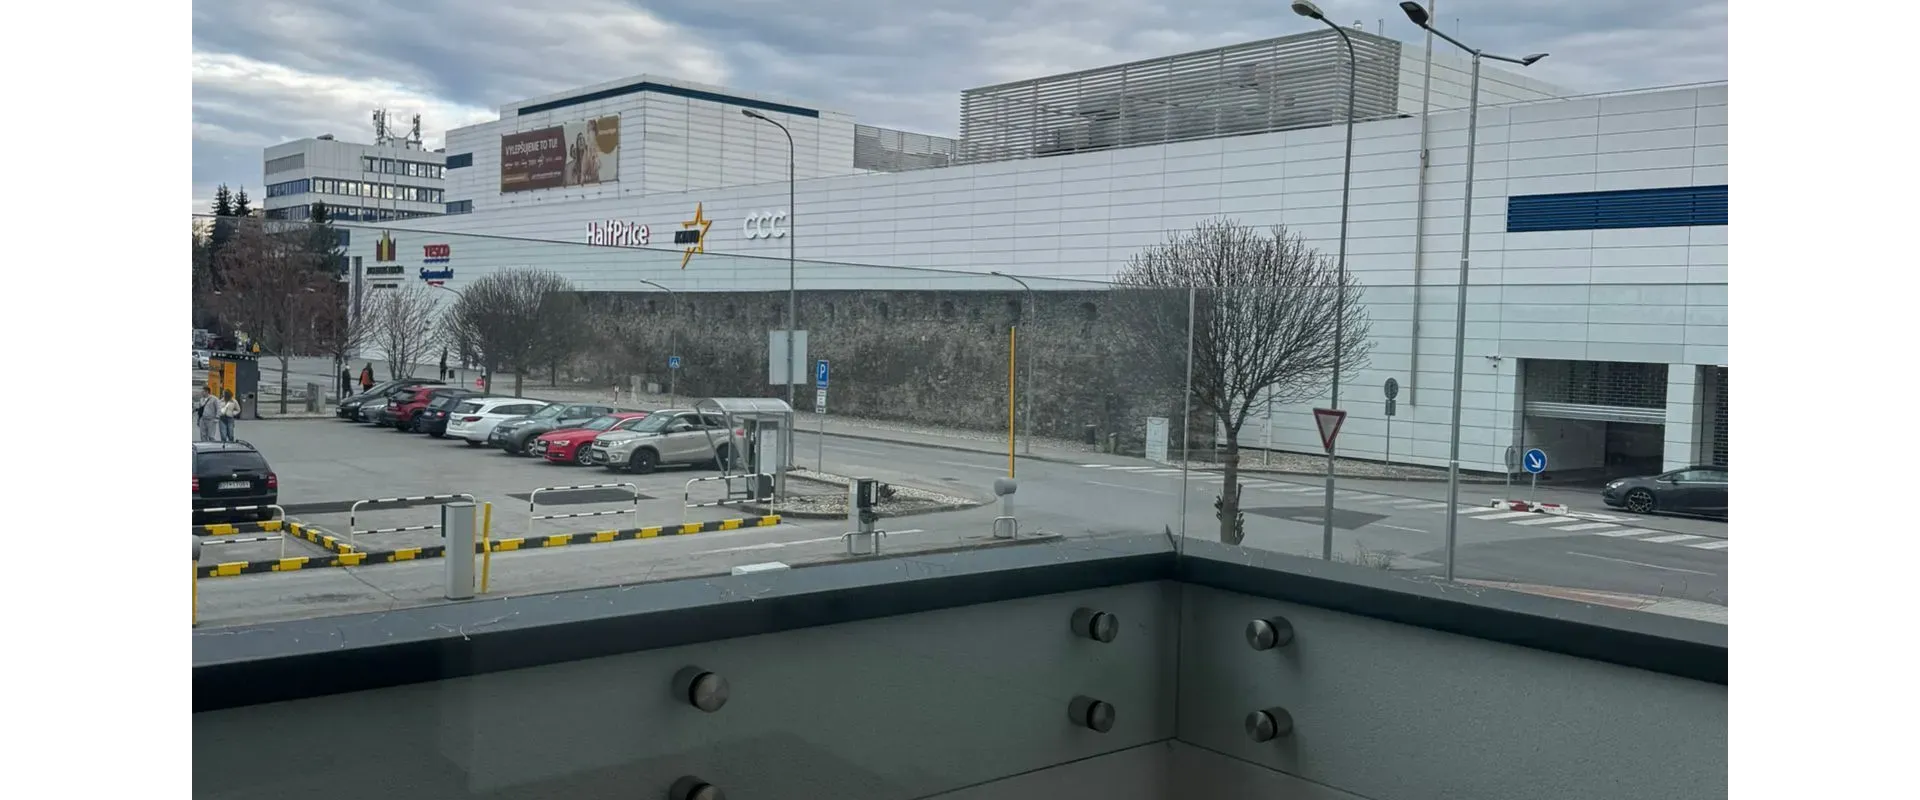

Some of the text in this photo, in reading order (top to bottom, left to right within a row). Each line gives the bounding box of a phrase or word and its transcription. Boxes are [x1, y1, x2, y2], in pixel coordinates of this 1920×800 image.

[505, 138, 558, 156] VYLEPŠUJEME TO TU!
[586, 219, 650, 247] HalfPrice
[743, 210, 786, 240] CCC
[423, 244, 451, 257] TESCO
[819, 363, 826, 379] P
